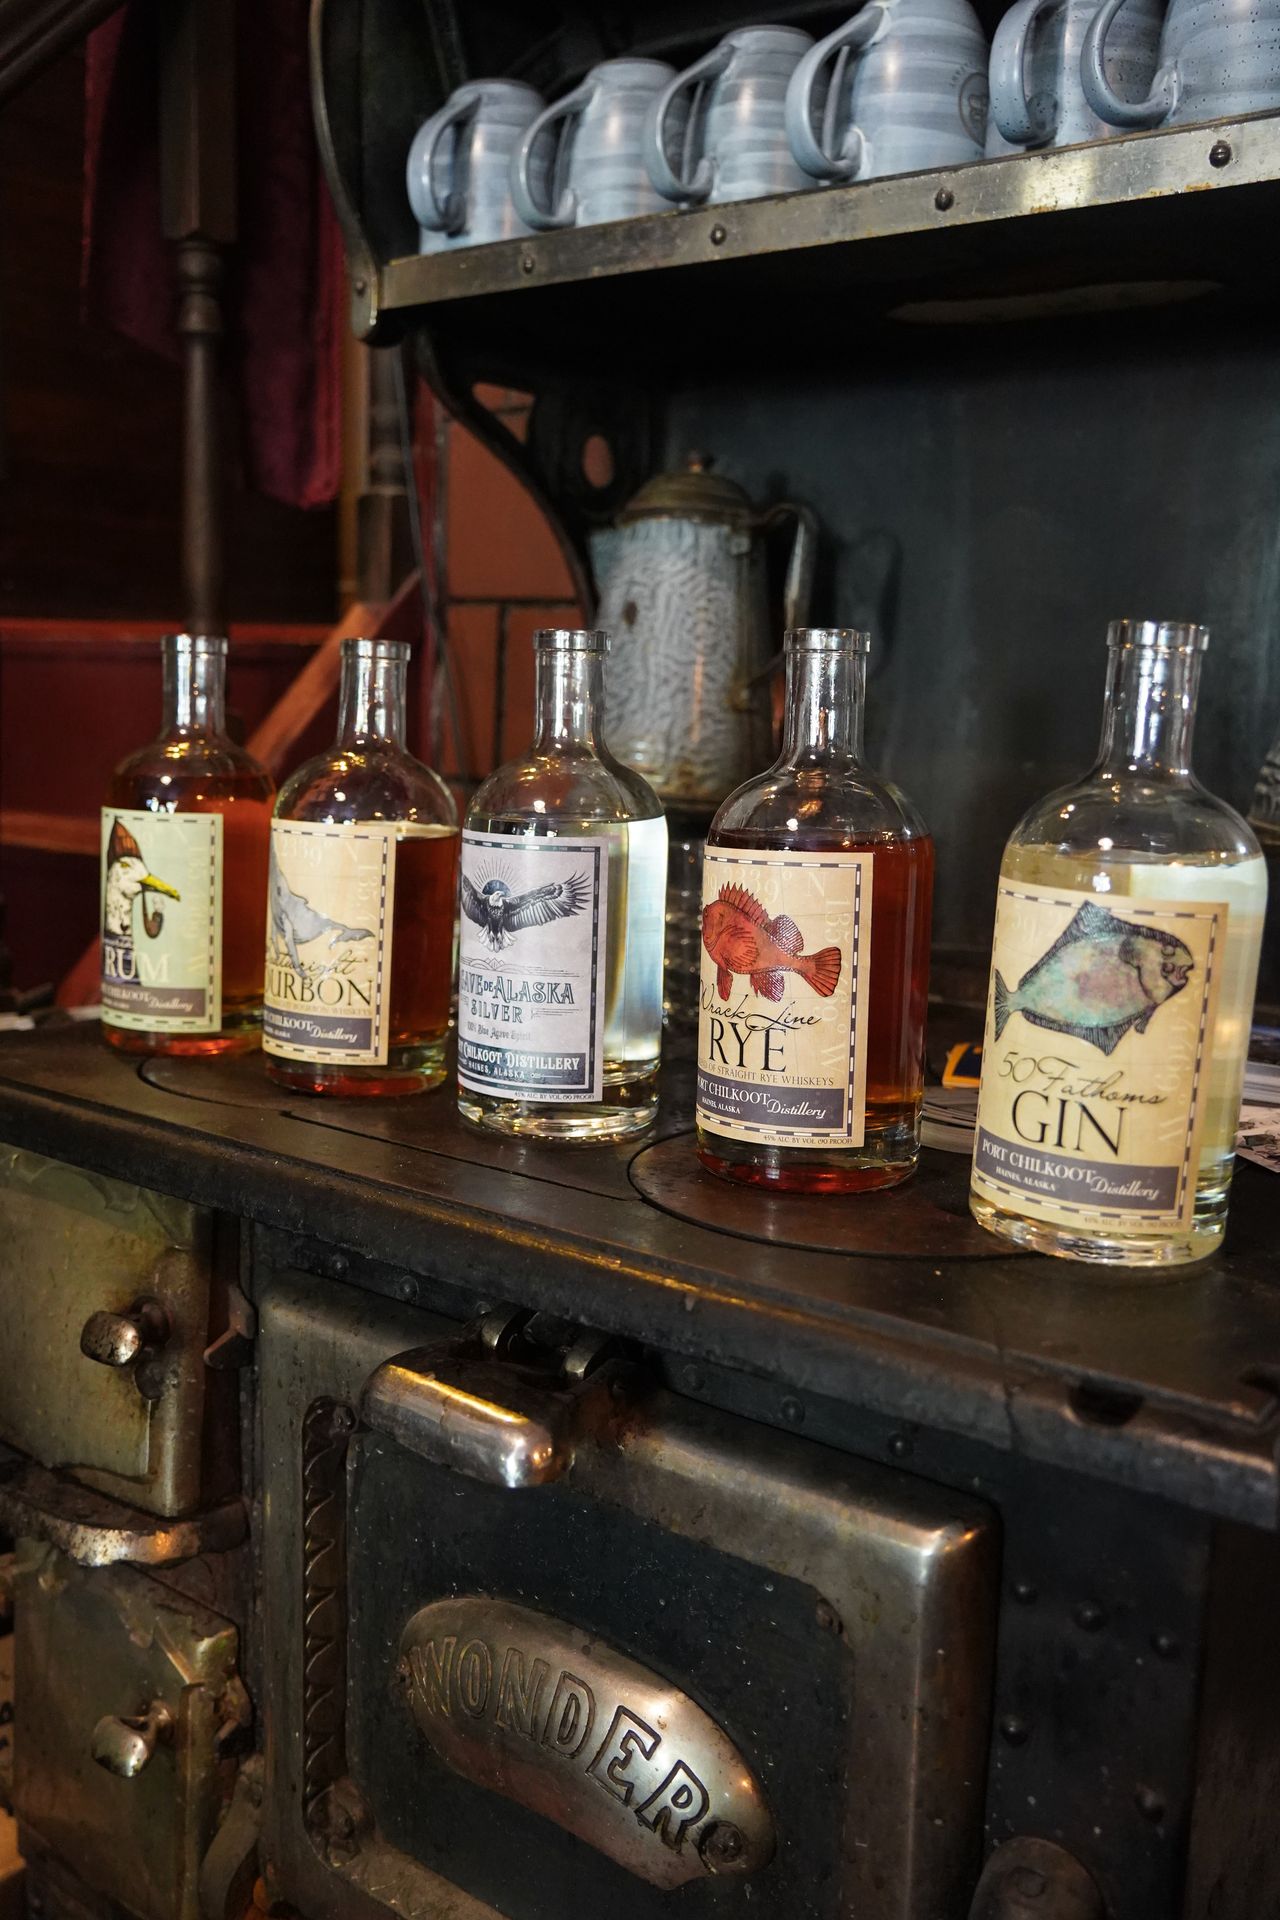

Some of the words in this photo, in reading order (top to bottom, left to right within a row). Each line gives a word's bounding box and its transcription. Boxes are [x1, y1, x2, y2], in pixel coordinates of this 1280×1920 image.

[104, 944, 171, 984] RUM
[264, 966, 374, 1007] URBON
[492, 975, 575, 1005] ALASKA
[470, 998, 523, 1024] SILVER
[309, 1025, 358, 1043] Distillery
[708, 1017, 787, 1073] RYE
[464, 1041, 502, 1065] CHILKOOT
[505, 1051, 580, 1071] DISTILLERY
[493, 1066, 525, 1080] ALASKA
[717, 1065, 757, 1081] STRAIGHT
[759, 1073, 778, 1084] RYE
[781, 1076, 834, 1087] WHISKEYS
[998, 1051, 1037, 1084] 50
[1036, 1055, 1168, 1105] Fathoms
[708, 1082, 771, 1106] CHILKOOT
[767, 1098, 827, 1120] Distillery
[717, 1102, 742, 1115] ALASKA
[1011, 1089, 1128, 1157] GIN
[981, 1138, 1008, 1162] PORT
[1009, 1151, 1096, 1184] CHILKOOT
[1090, 1175, 1159, 1200] Distillery
[1023, 1176, 1056, 1192] ALASKA
[408, 1636, 710, 1855] WONDER
